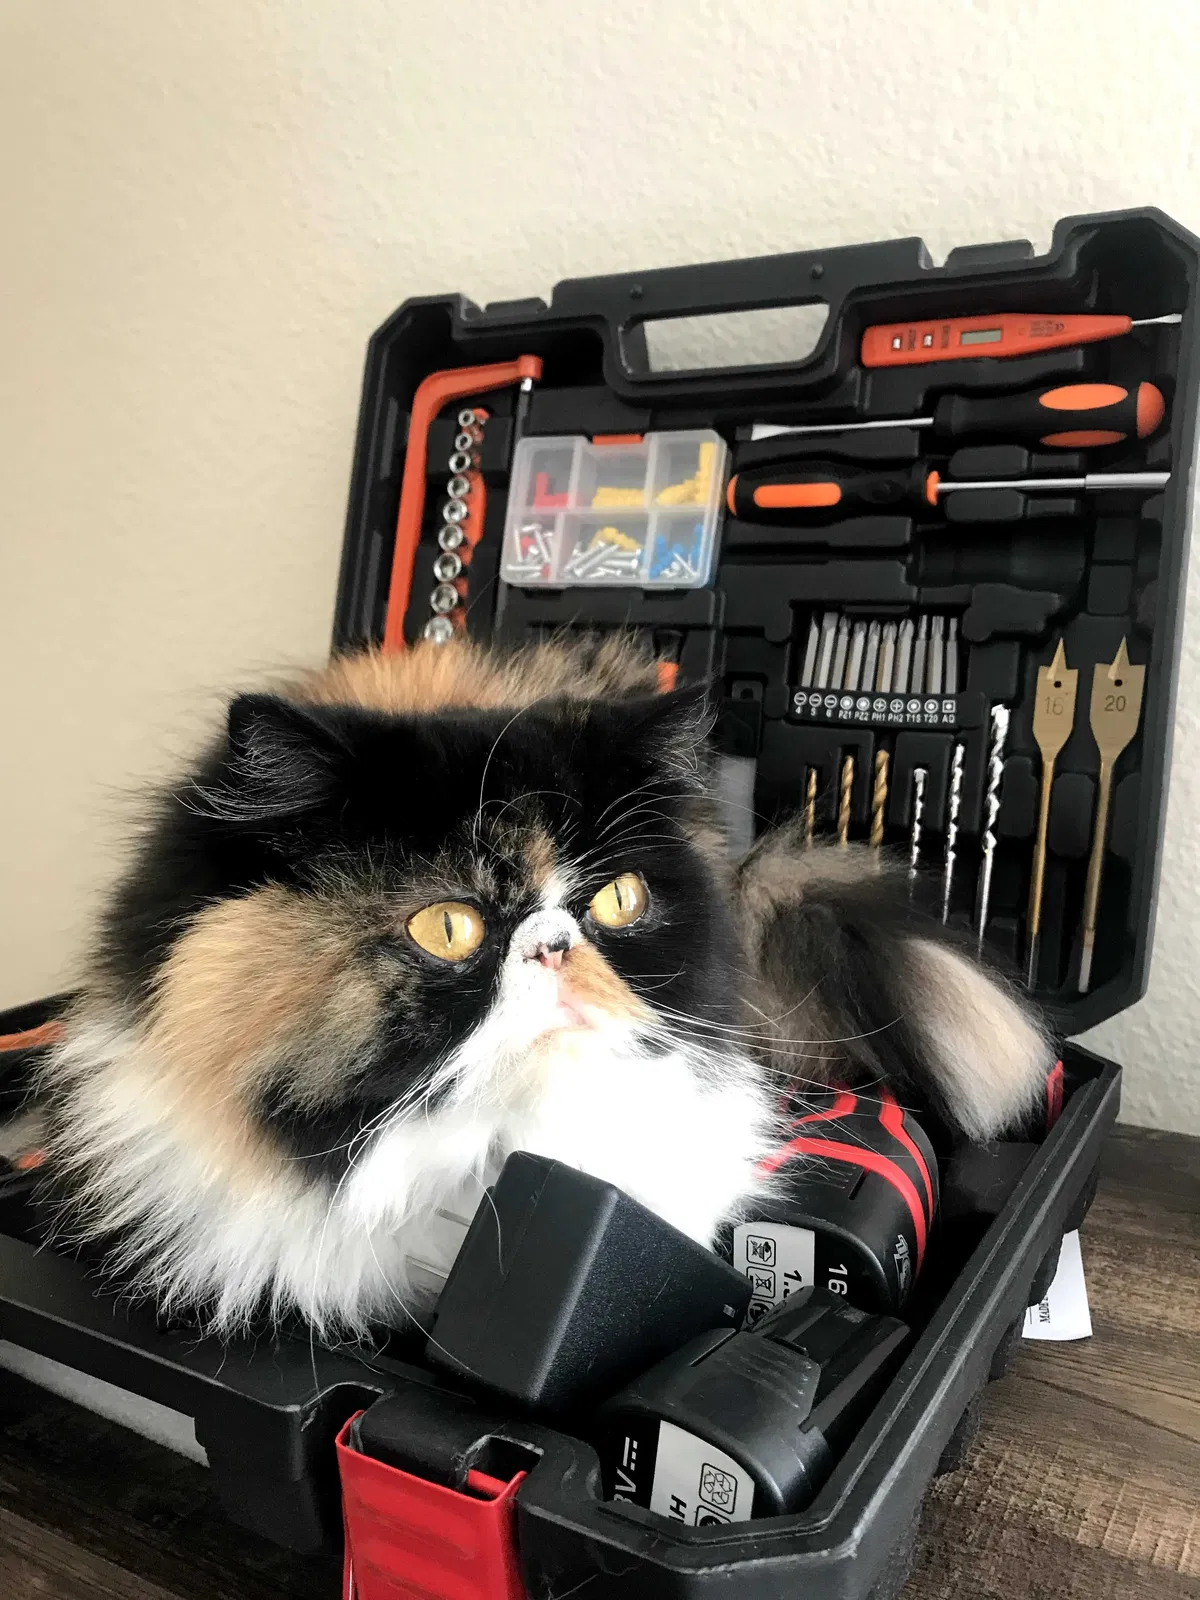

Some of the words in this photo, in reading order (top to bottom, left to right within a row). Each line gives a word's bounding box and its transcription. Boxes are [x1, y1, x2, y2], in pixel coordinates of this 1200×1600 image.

[1044, 696, 1064, 715] 16
[1104, 695, 1126, 712] 20
[795, 706, 802, 714] 4
[826, 709, 832, 718] 6
[838, 710, 852, 719] PZ1
[854, 711, 869, 721] PZ2
[871, 712, 886, 722] PH1
[887, 712, 904, 723] PH2
[924, 713, 939, 724] T20
[668, 1494, 687, 1523] H
